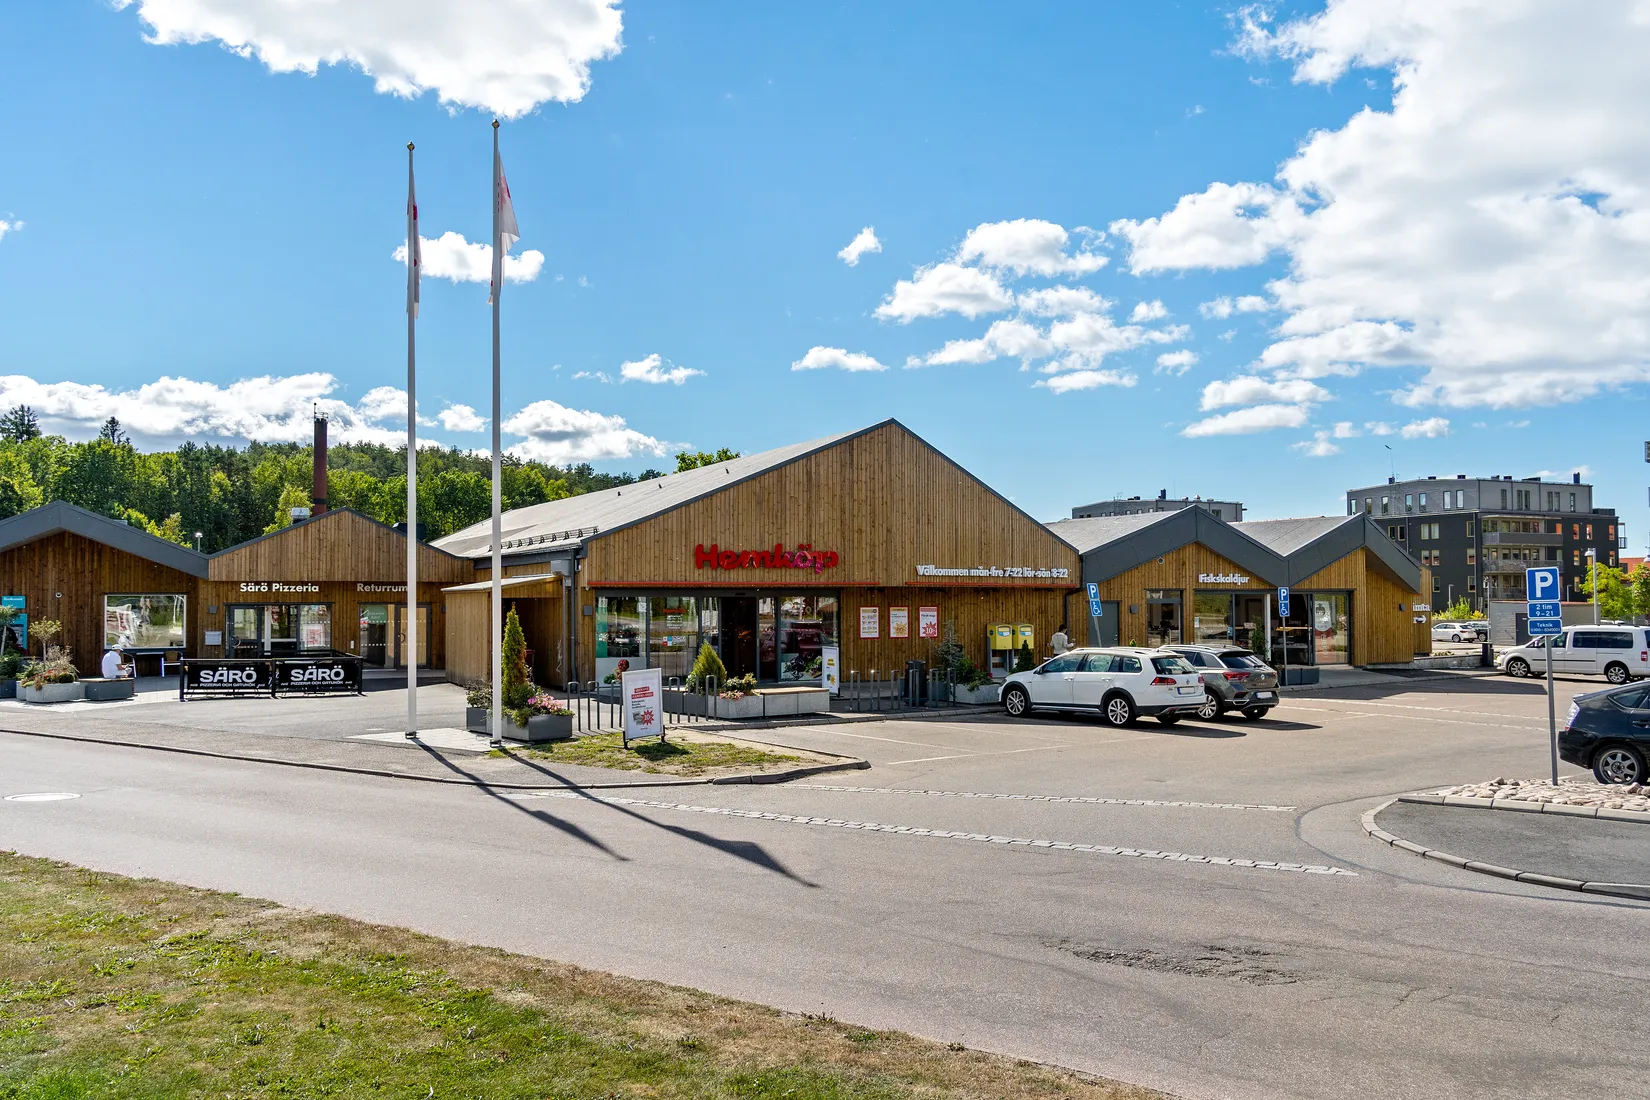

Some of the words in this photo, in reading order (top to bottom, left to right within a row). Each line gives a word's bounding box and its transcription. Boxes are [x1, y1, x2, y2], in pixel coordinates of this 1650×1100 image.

[695, 543, 839, 574] Hemköp
[916, 564, 969, 576] Välkommen
[969, 565, 1004, 577] mån-fre
[1004, 567, 1023, 577] 7-22
[1023, 567, 1051, 578] lör-sön
[1051, 568, 1069, 578] 8-22
[240, 582, 268, 592] Särö
[272, 582, 319, 592] Pizzeria
[1090, 585, 1096, 598] P
[1535, 571, 1553, 598] P
[1281, 589, 1287, 600] P
[200, 667, 257, 683] SÄRÖ
[290, 665, 345, 681] SÄRÖ
